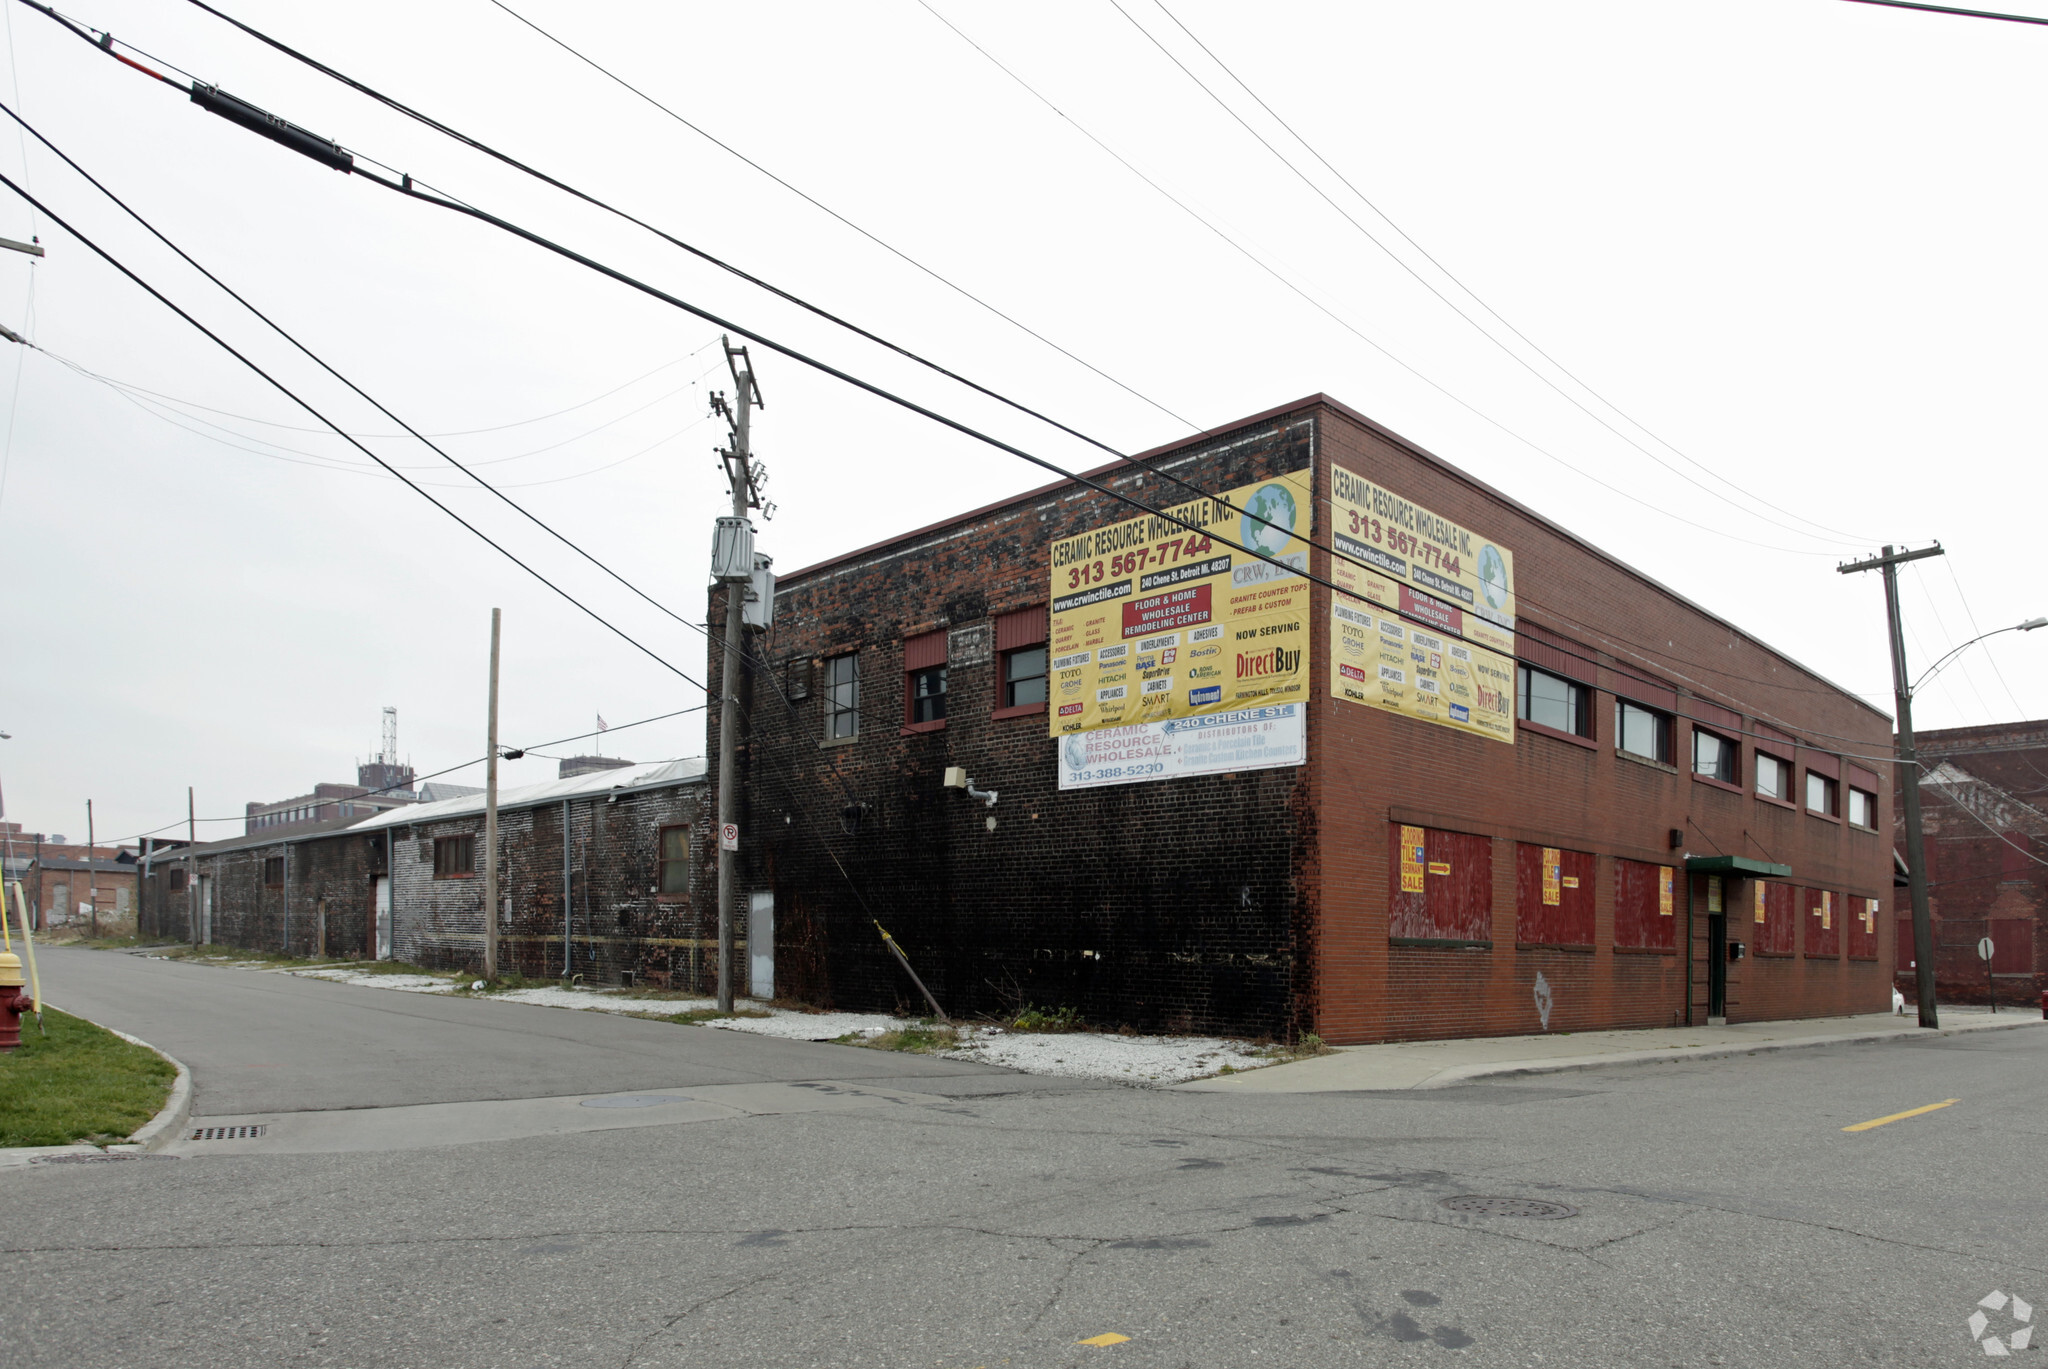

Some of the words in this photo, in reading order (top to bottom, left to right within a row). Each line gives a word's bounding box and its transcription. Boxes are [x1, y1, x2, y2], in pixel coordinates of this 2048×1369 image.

[1334, 468, 1371, 510] CERAMIC
[1373, 487, 1414, 531] RESOURCE
[1415, 507, 1458, 552] WHOLESALE
[1459, 529, 1473, 558] INC.
[1053, 535, 1092, 568] CERAMIC
[1095, 519, 1145, 557] RESOURCE
[1148, 501, 1209, 541] WHOLESALE
[1212, 495, 1234, 524] INC.
[1349, 509, 1382, 544] 313
[1388, 525, 1461, 578] 567-7744
[1069, 561, 1104, 589] 313
[1111, 533, 1212, 577] 567-7744
[1335, 537, 1405, 576] www.crwinctile.com
[1142, 576, 1152, 588] 240
[1153, 573, 1170, 586] Chene
[1171, 571, 1179, 582] St.
[1180, 566, 1200, 580] Detroit
[1211, 558, 1230, 574] 48207
[1054, 583, 1131, 612] www.crwinctile.com
[1135, 599, 1160, 611] FLOOR
[1163, 596, 1169, 604] &
[1172, 589, 1197, 602] HOME
[1230, 592, 1257, 605] GRANITE
[1258, 586, 1289, 599] COUNTER
[1290, 583, 1308, 592] TOPS
[1408, 588, 1428, 603] FLOOR
[1141, 603, 1190, 621] WHOLESALE
[1233, 605, 1257, 616] PREFAB
[1264, 598, 1292, 610] CUSTOM
[1413, 602, 1449, 623] WHOLESALE
[1124, 616, 1175, 636] REMODELING
[1177, 610, 1208, 625] CENTER
[1236, 629, 1257, 641] NOW
[1259, 621, 1300, 637] SERVING
[1085, 628, 1101, 637] GLASS
[1194, 627, 1218, 641] ADHESIVES
[1342, 624, 1364, 639] TOTO
[1141, 635, 1175, 652] UNDERLAYMENTS
[1342, 636, 1364, 650] GROHE
[1100, 645, 1126, 659] ACCESSORIES
[1190, 647, 1217, 658] Bostik
[1379, 652, 1404, 666] HITACHI
[1099, 659, 1127, 669] Panasonic
[1136, 660, 1156, 670] BASE
[1237, 647, 1301, 679] DirectBuy
[1060, 668, 1082, 679] TOTO
[1098, 673, 1127, 685] HITACHI
[1346, 667, 1364, 680] DELTA
[1060, 679, 1082, 689] GROHE
[1147, 680, 1167, 692] CABINETS
[1100, 687, 1124, 700] APPLIANCES
[1143, 693, 1170, 707] SMART
[1344, 688, 1365, 700] KOHLER
[1416, 692, 1438, 707] SMART
[1477, 684, 1510, 719] DirectBuy
[1064, 704, 1082, 714] DELTA
[1100, 703, 1126, 714] Whirlpool
[1174, 719, 1200, 730] 240
[1204, 709, 1260, 725] CHENE
[1265, 706, 1288, 717] ST.
[1062, 722, 1082, 732] KOHLER
[1086, 724, 1149, 741] CERAMIC
[1198, 724, 1258, 740] DISTRIBUTORS
[1086, 734, 1161, 752] RESOURCE
[1218, 736, 1252, 751] Porcelain
[1252, 735, 1266, 746] Tile
[1086, 745, 1172, 764] WHOLESALE
[1236, 748, 1263, 763] Kitchen
[1264, 744, 1298, 758] Counters
[1070, 763, 1164, 782] 313-388-5230
[1402, 845, 1415, 862] TILE
[1402, 875, 1423, 890] SALE
[1543, 890, 1560, 903] SALE
